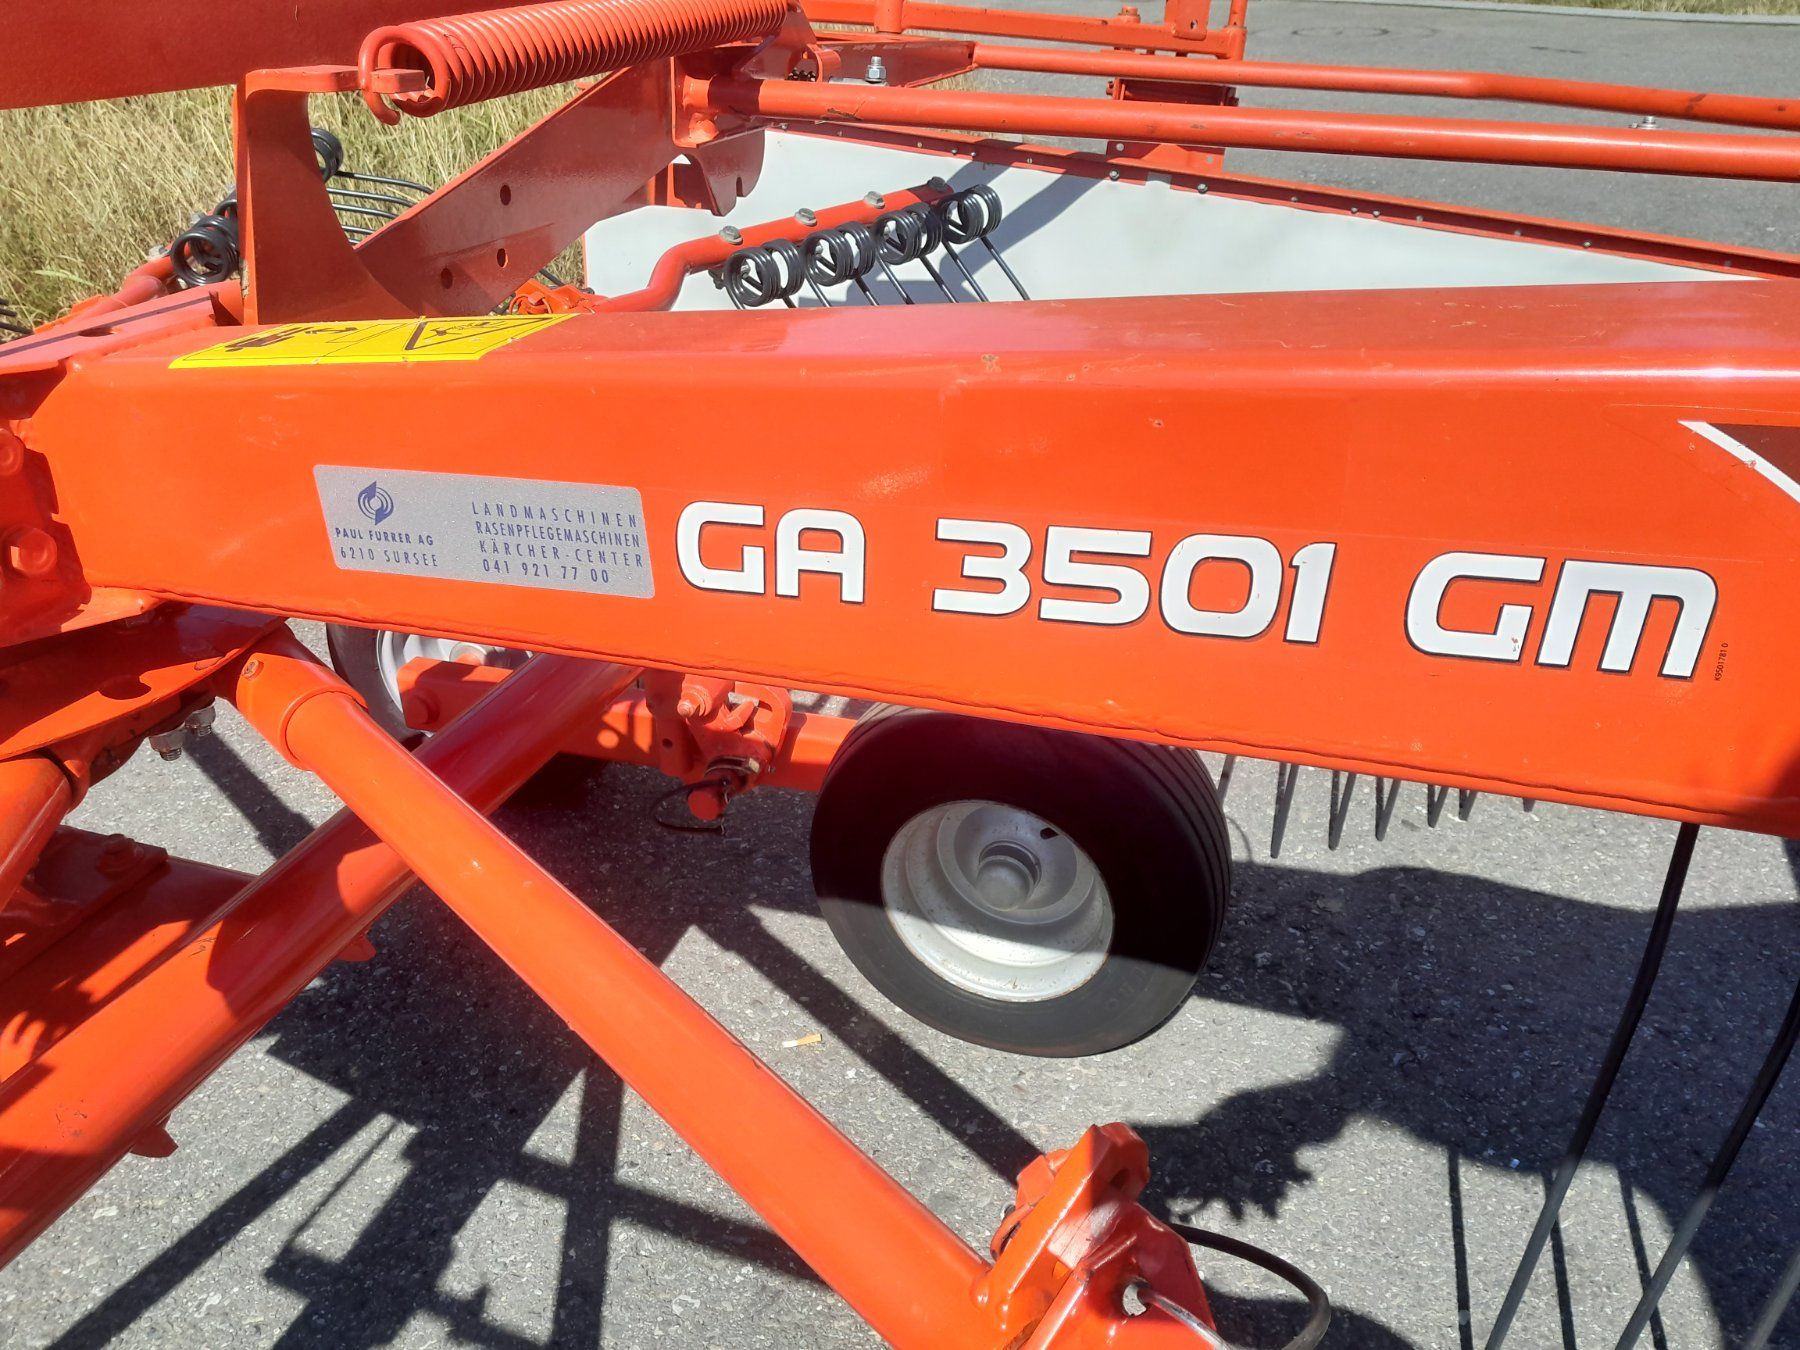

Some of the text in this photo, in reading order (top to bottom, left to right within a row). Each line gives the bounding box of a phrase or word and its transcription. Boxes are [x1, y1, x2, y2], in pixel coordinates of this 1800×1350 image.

[472, 502, 637, 528] LANDMASCHINEN
[335, 527, 434, 546] PAUL FURRER AG
[476, 520, 640, 548] RASENPFLEGEMASCHINEN
[340, 547, 438, 567] 6210 SURSEE
[482, 558, 609, 583] 041 921 77 00
[675, 500, 1718, 681] GA 3501 GM
